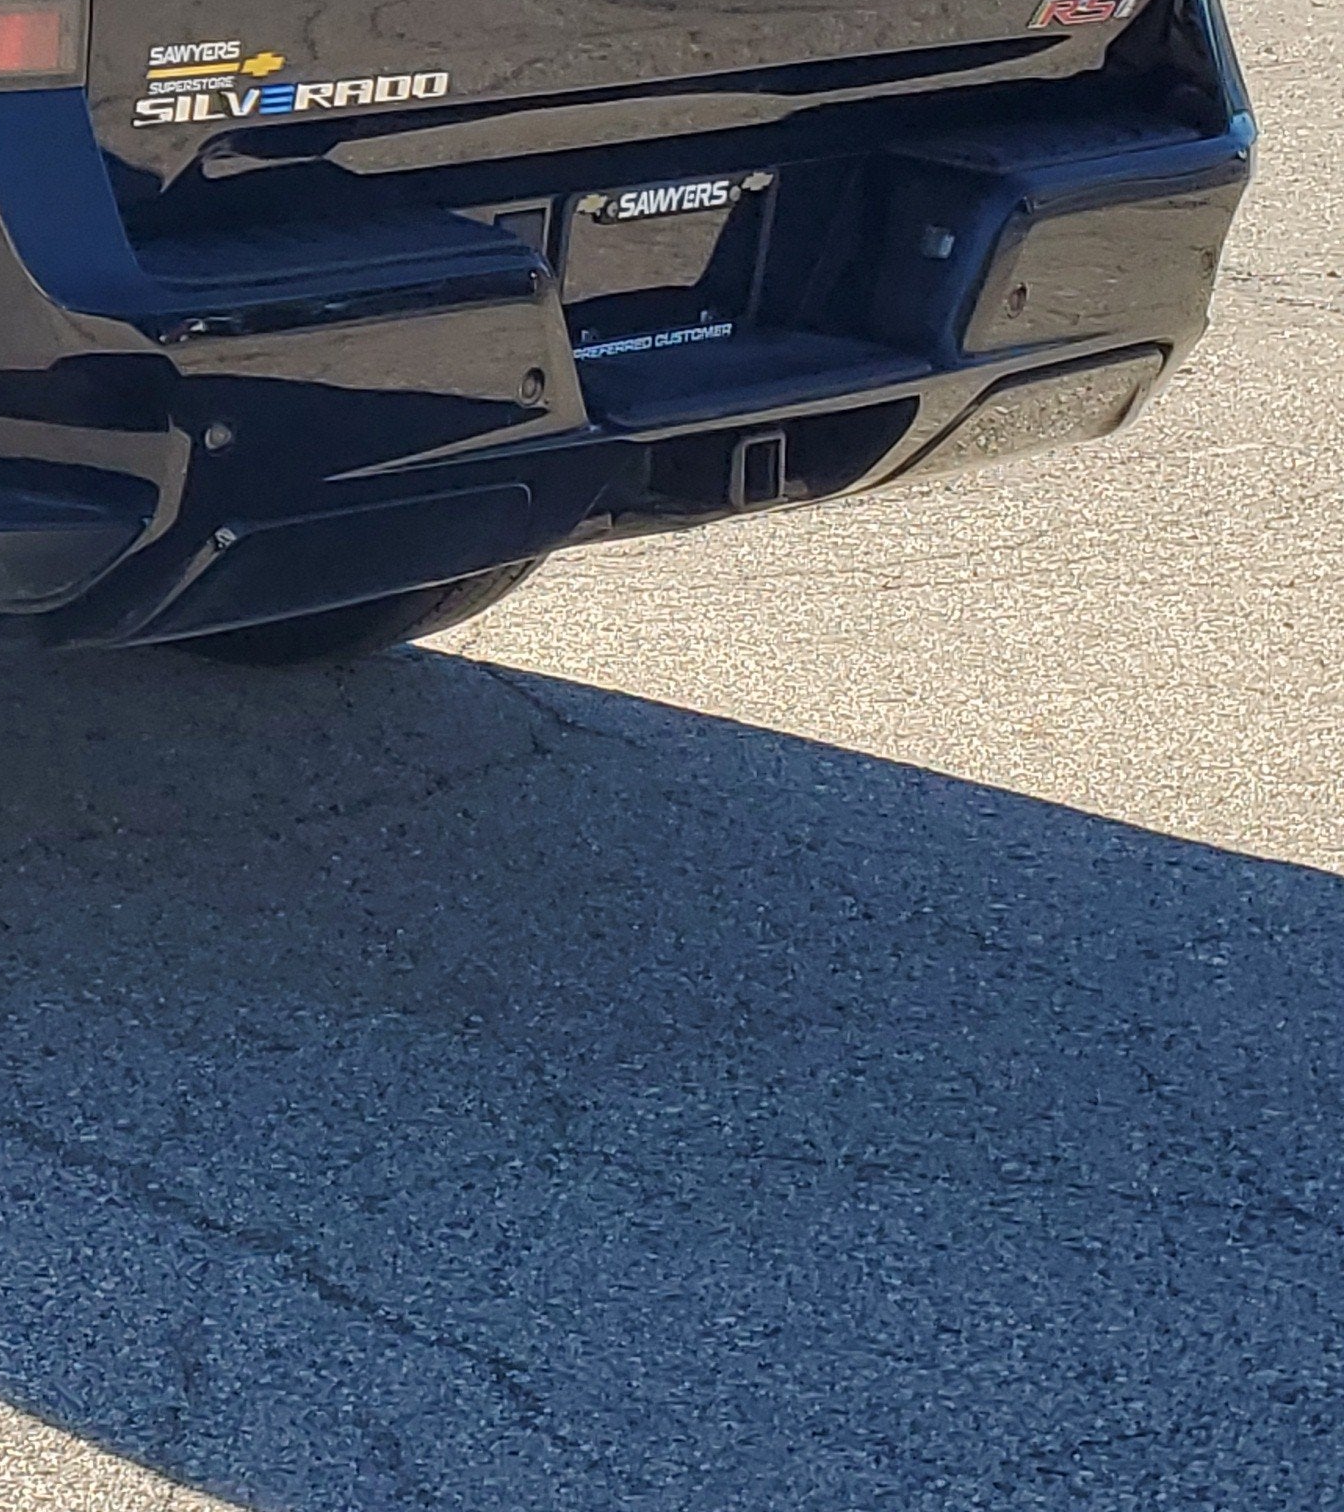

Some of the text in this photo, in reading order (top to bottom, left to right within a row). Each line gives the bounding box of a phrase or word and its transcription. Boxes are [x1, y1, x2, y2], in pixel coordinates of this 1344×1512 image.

[148, 40, 242, 66] SAWYERS
[131, 71, 450, 127] SILVERADO
[148, 76, 235, 96] SUPERSTORE
[618, 180, 730, 219] SAWYERS
[573, 322, 733, 360] PREFERRED CUSTOMER
